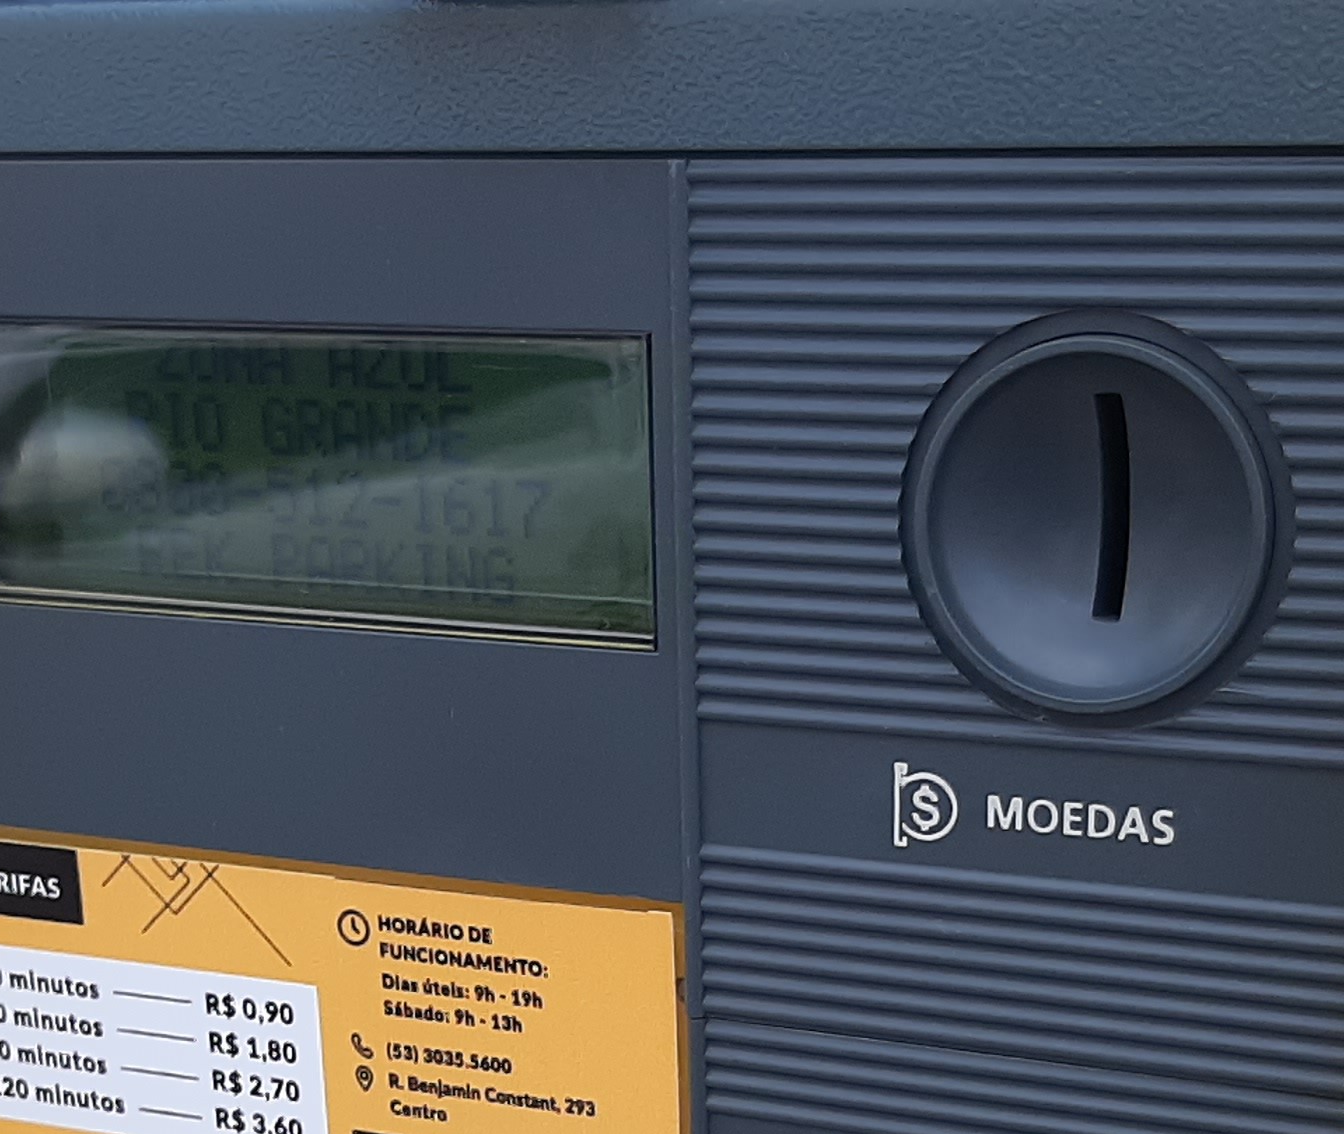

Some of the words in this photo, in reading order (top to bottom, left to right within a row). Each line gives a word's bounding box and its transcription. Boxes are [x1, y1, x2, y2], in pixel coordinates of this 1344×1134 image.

[262, 396, 473, 463] GRANDE
[271, 533, 515, 604] PARKING
[987, 795, 1175, 845] MOEDAS
[378, 914, 464, 941] HORÁRIO
[468, 925, 493, 945] DE
[380, 942, 549, 979] FUNCIONAMENTO:
[10, 968, 99, 999] minutos
[206, 993, 236, 1018] R$
[243, 998, 294, 1025] 0,90
[381, 973, 418, 993] Dias
[423, 977, 470, 999] úteis:
[475, 985, 496, 1004] 9h
[511, 990, 543, 1010] 19h
[14, 1006, 103, 1038] minutos
[209, 1031, 239, 1057] R$
[247, 1037, 297, 1064] 1,80
[384, 1000, 451, 1023] Sábado:
[455, 1009, 476, 1028] 9h
[492, 1013, 523, 1033] 13h
[18, 1043, 107, 1075] minutos
[212, 1069, 242, 1096] R$
[250, 1076, 300, 1102] 2,70
[386, 1041, 419, 1065] (53)
[423, 1047, 512, 1075] 3035.5600
[36, 1083, 125, 1114] minutos
[216, 1107, 245, 1134] R$
[389, 1072, 404, 1090] R.
[408, 1075, 481, 1102] Benjamin
[485, 1087, 561, 1115] Constant,
[565, 1098, 596, 1117] 293
[389, 1100, 448, 1122] Centro
